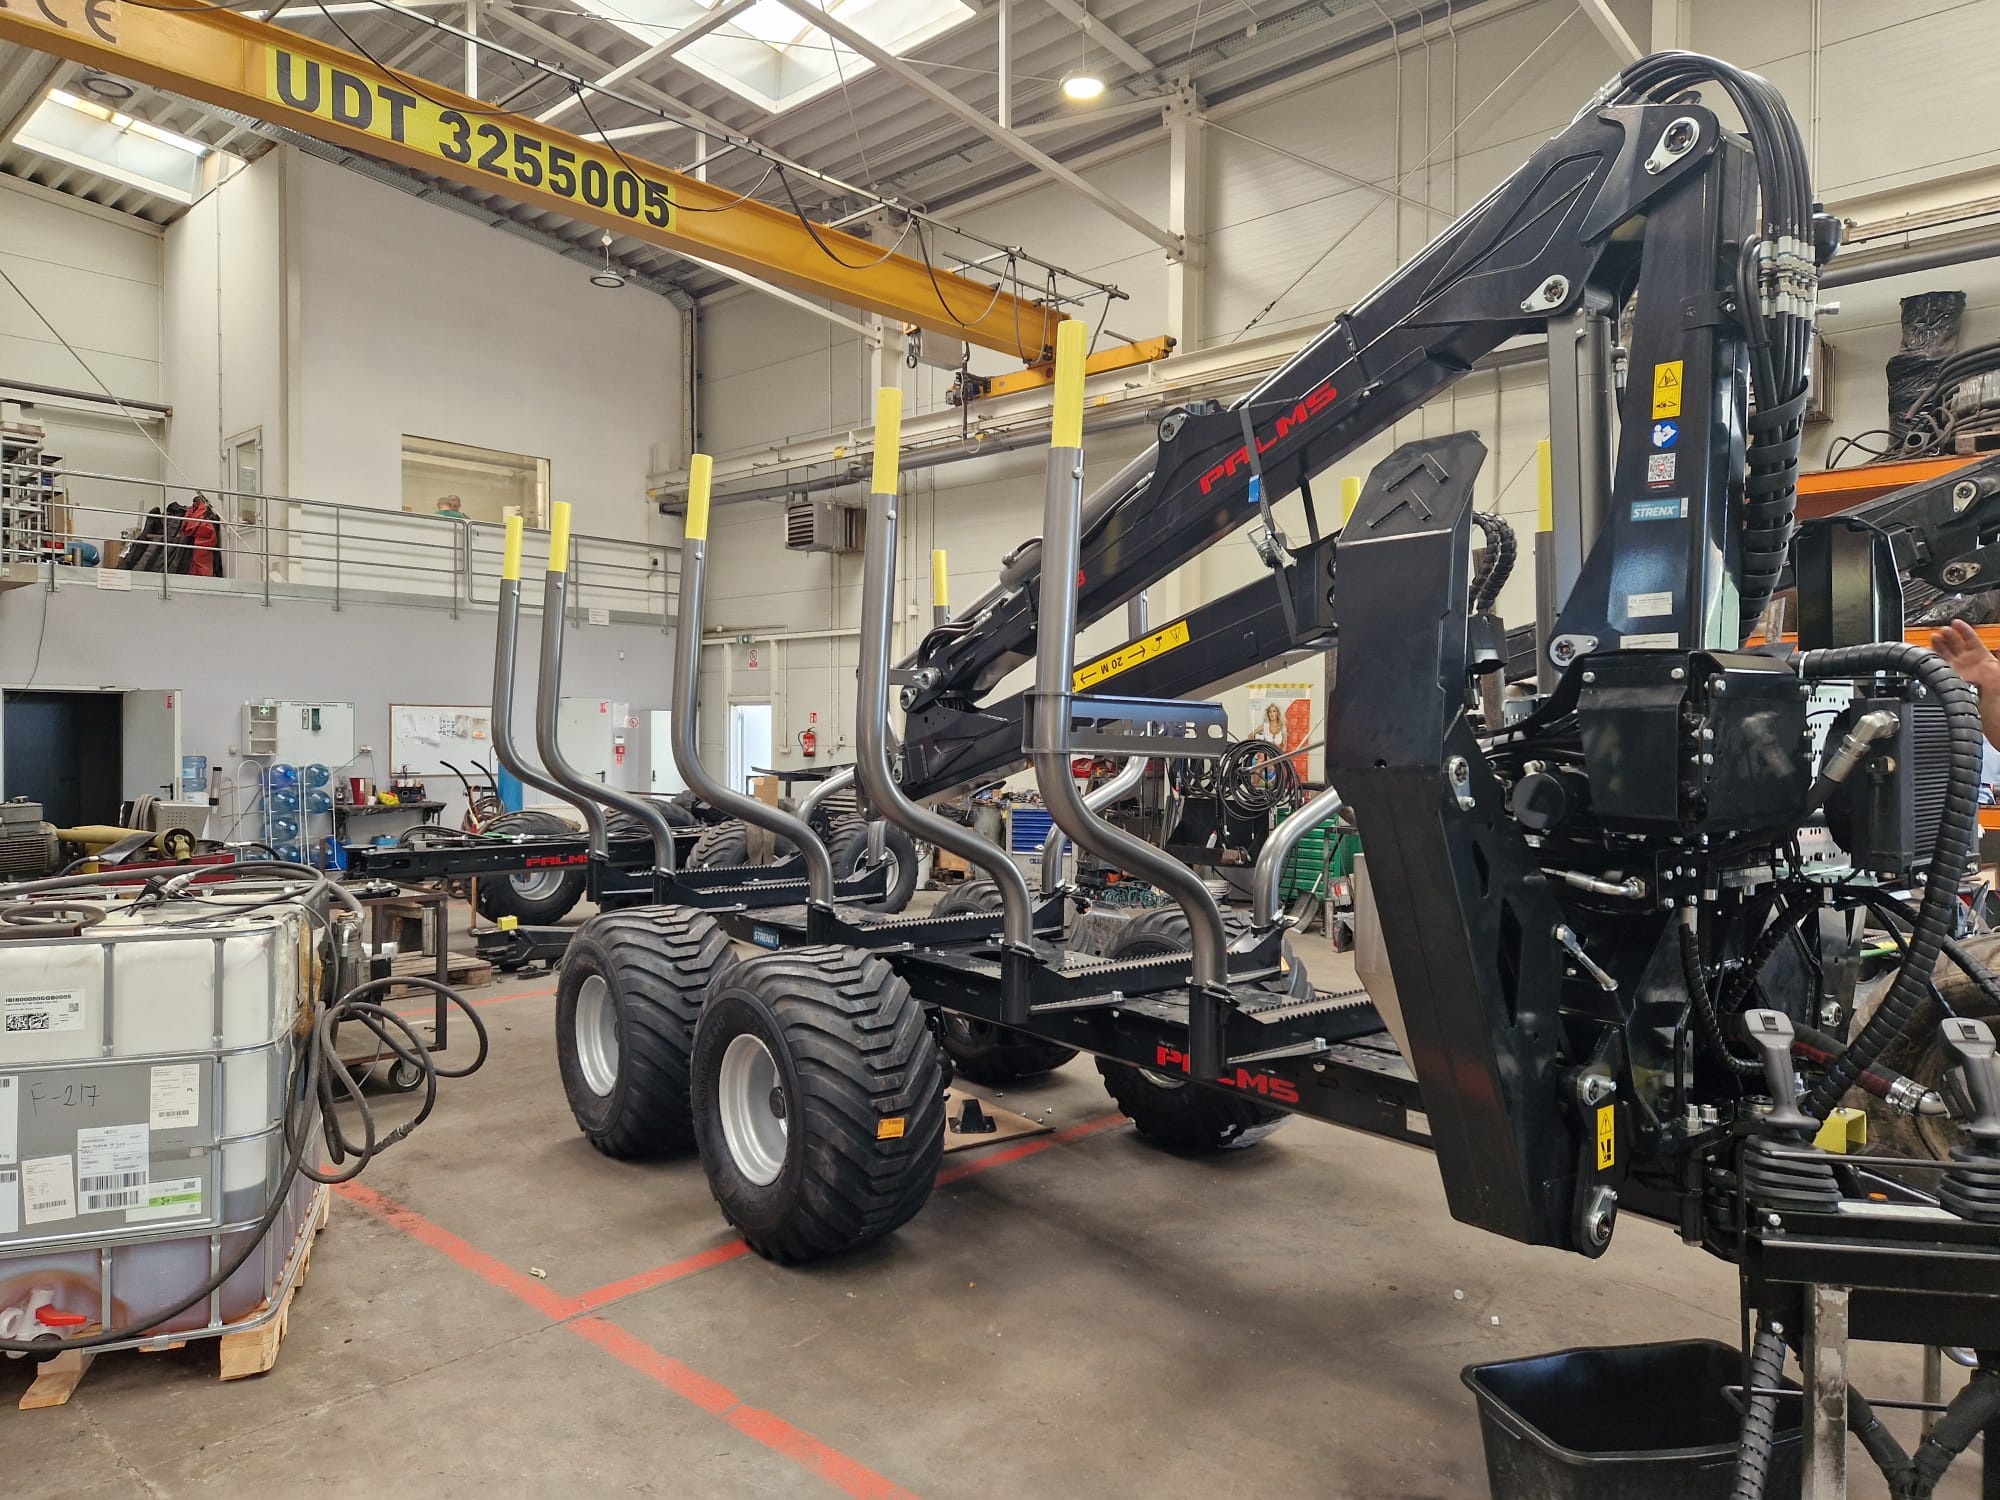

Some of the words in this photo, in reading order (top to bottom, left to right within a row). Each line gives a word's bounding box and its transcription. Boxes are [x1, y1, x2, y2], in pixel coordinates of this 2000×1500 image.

[276, 49, 417, 144] UDT
[438, 110, 670, 229] 3255005
[1199, 381, 1338, 496] PALMS
[1632, 506, 1674, 518] STRENX
[1100, 664, 1110, 675] M
[1111, 656, 1124, 670] 20
[31, 1081, 100, 1117] F-217
